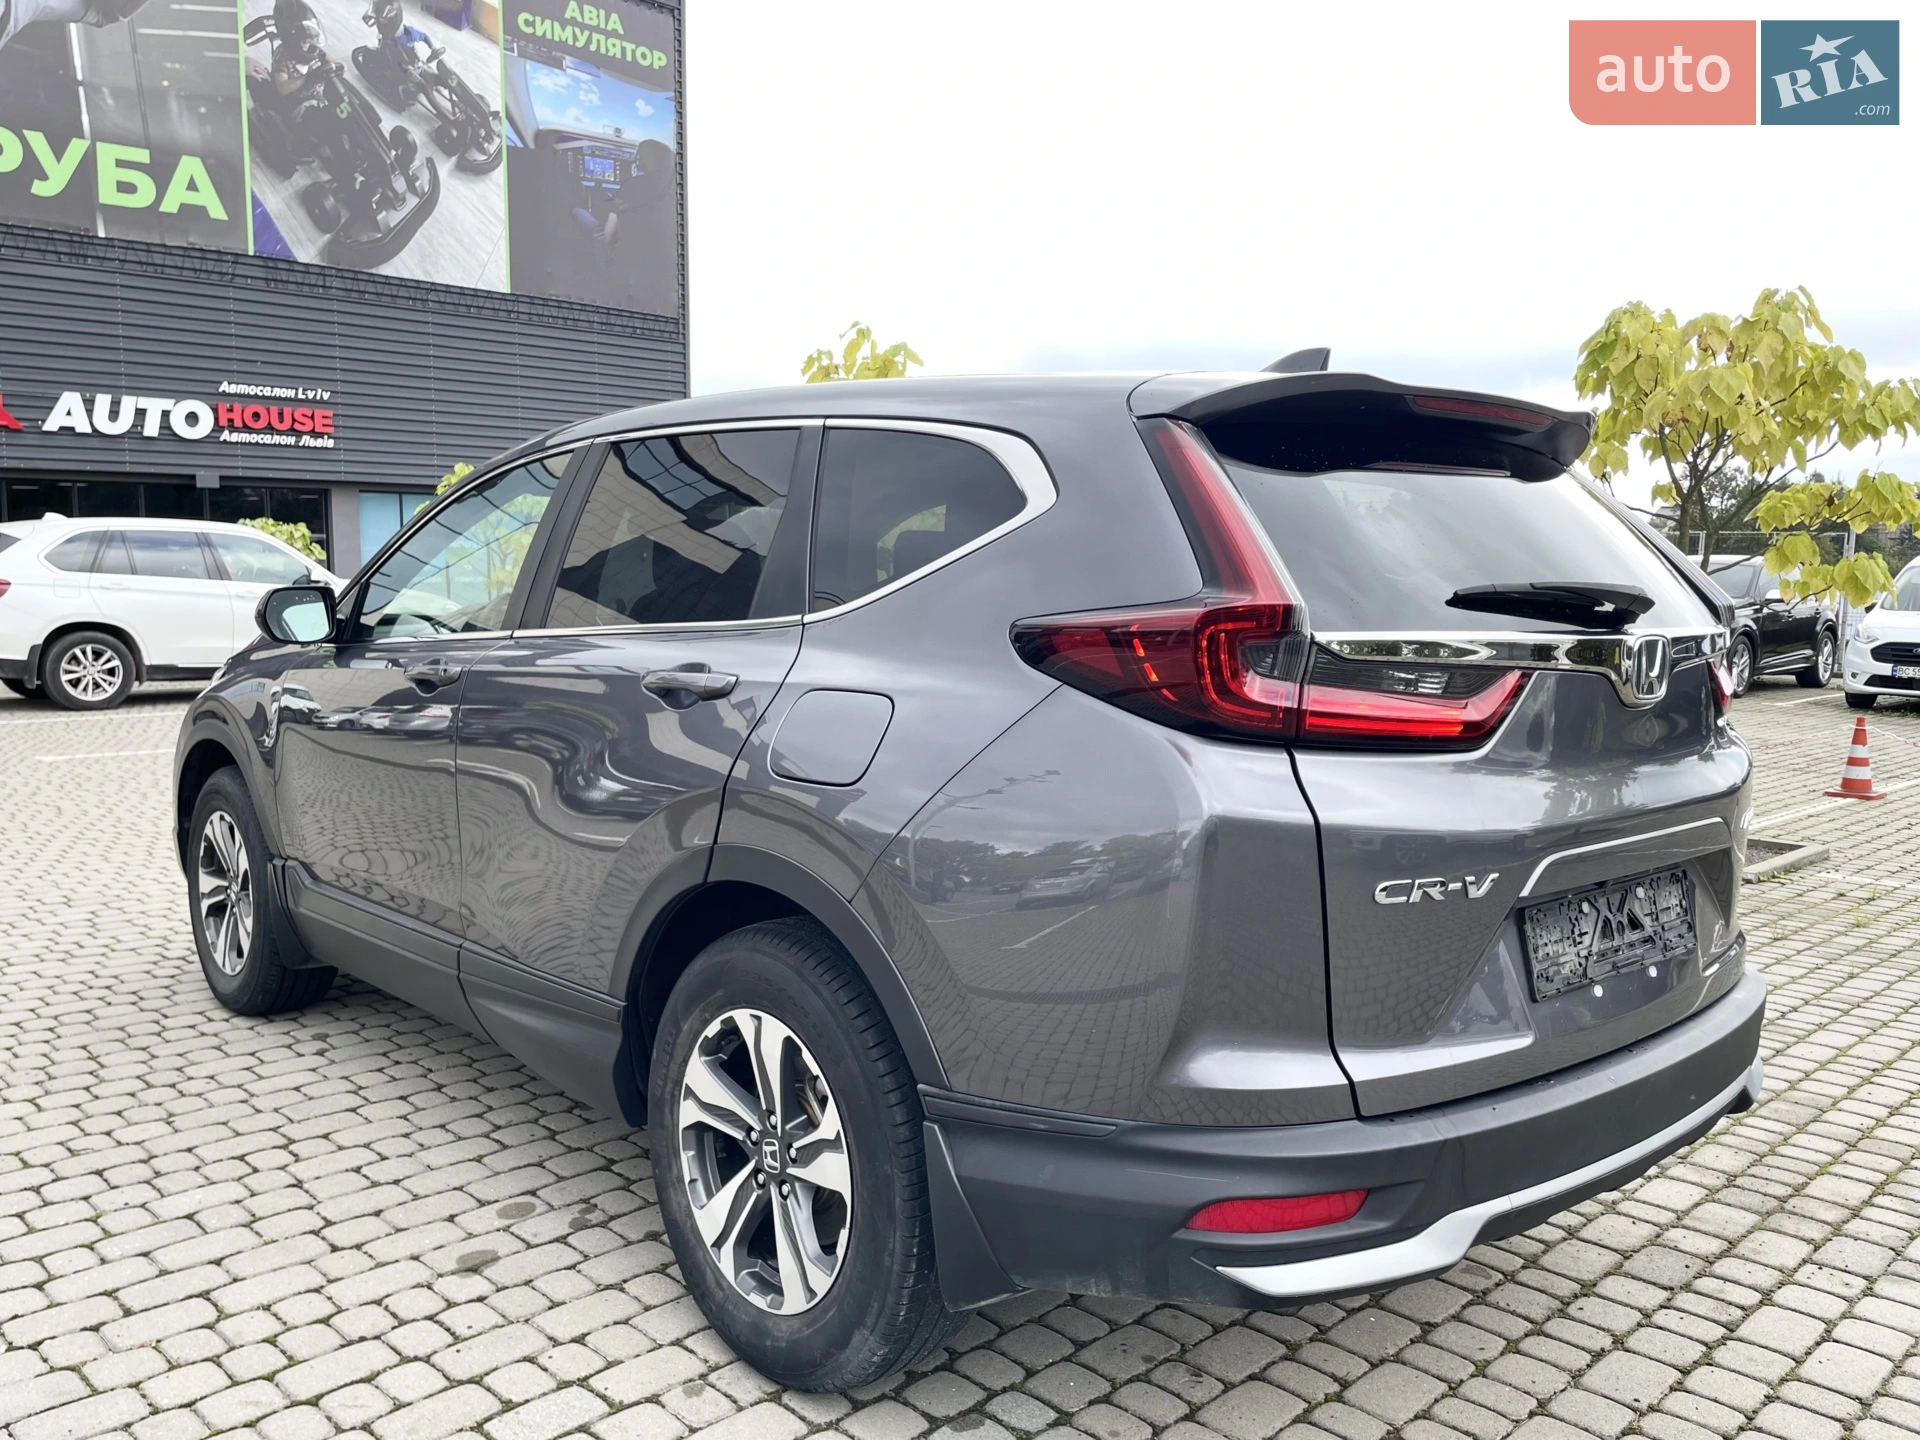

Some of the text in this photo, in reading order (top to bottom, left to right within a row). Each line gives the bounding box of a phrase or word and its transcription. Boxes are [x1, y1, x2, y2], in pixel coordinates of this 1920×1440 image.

[564, 0, 624, 34] АВІА
[517, 12, 668, 70] СИМУЛЯТОР
[218, 380, 296, 398] Автосалон
[41, 391, 335, 440] AUTO HOUSE
[219, 429, 335, 449] Автосалон Львів
[1374, 872, 1500, 905] CR-V
